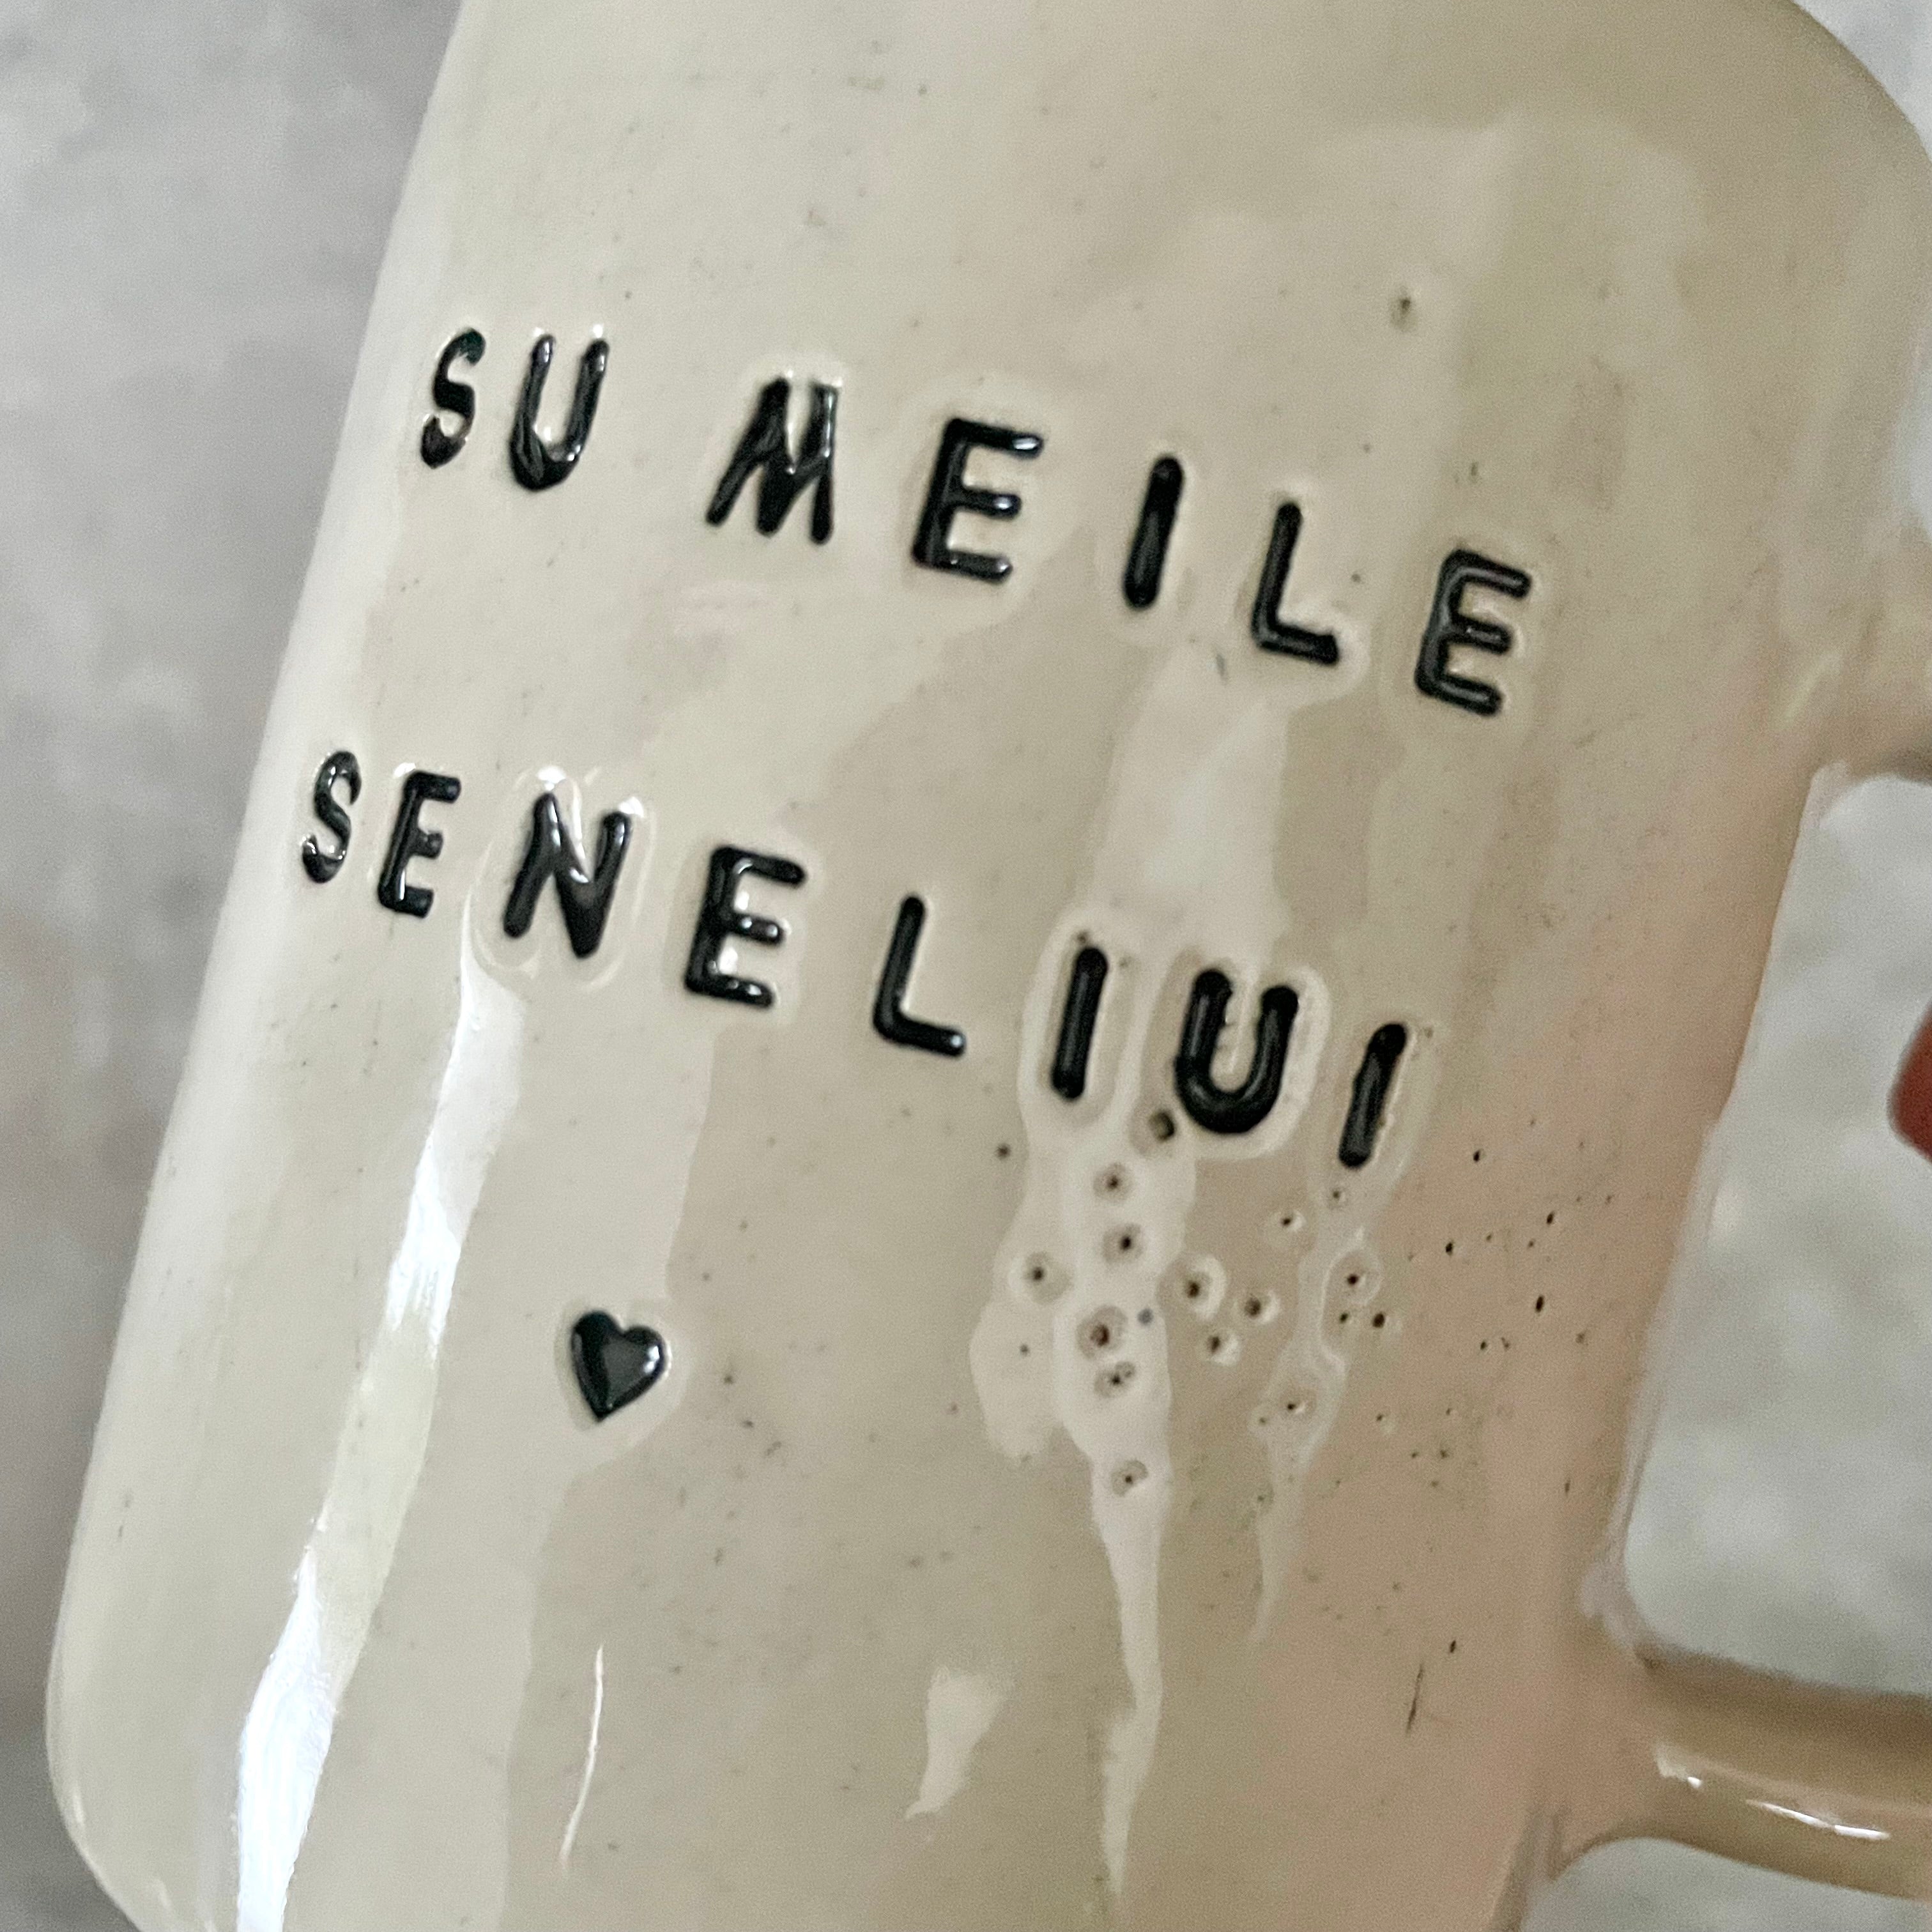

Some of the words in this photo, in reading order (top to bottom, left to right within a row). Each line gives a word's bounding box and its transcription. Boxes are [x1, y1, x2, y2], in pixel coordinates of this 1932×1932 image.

[419, 328, 609, 493] SU
[705, 378, 1533, 718] MEILE
[301, 751, 1409, 1172] SENELIUI
